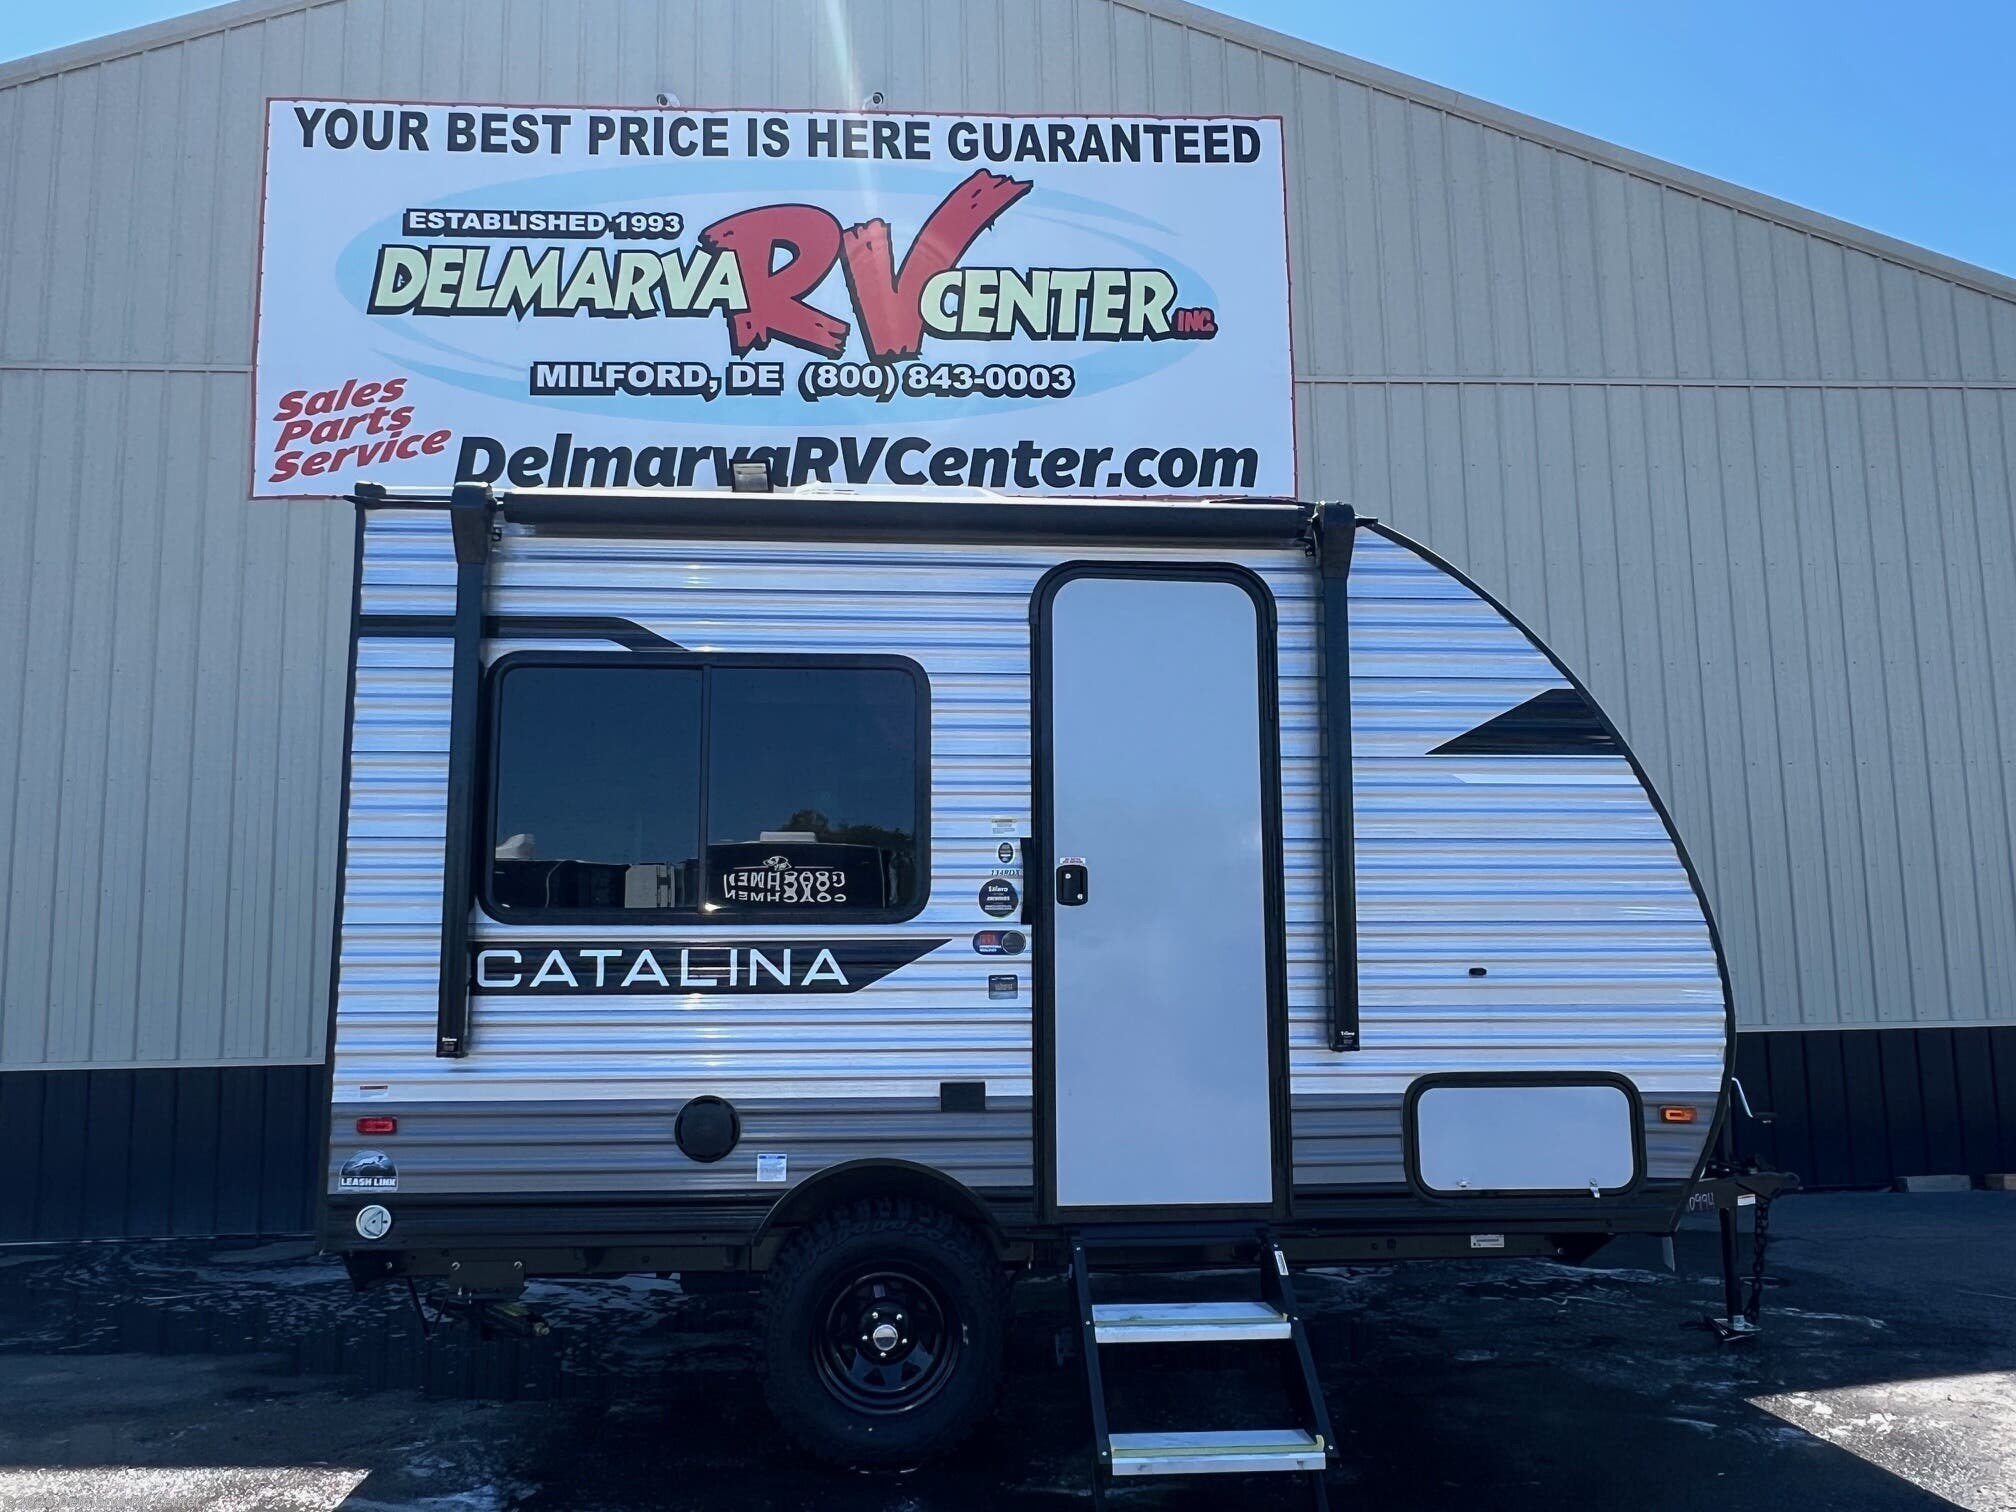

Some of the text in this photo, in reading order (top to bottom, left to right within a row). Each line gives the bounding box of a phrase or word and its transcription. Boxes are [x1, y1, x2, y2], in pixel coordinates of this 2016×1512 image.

[294, 107, 1260, 163] YOUR BEST PRICE IS HERE GUARANTEED
[404, 209, 683, 238] ESTABLISHED 1993
[367, 168, 1218, 363] DELMARVA RV CENTER INC.
[273, 377, 408, 422] Sales
[532, 362, 1075, 402] MILFORD, DE (800) 843-0003
[272, 402, 415, 452] Parts
[267, 428, 452, 483] Service
[477, 948, 850, 988] CATALINA
[341, 1177, 396, 1187] LEASH LINK
